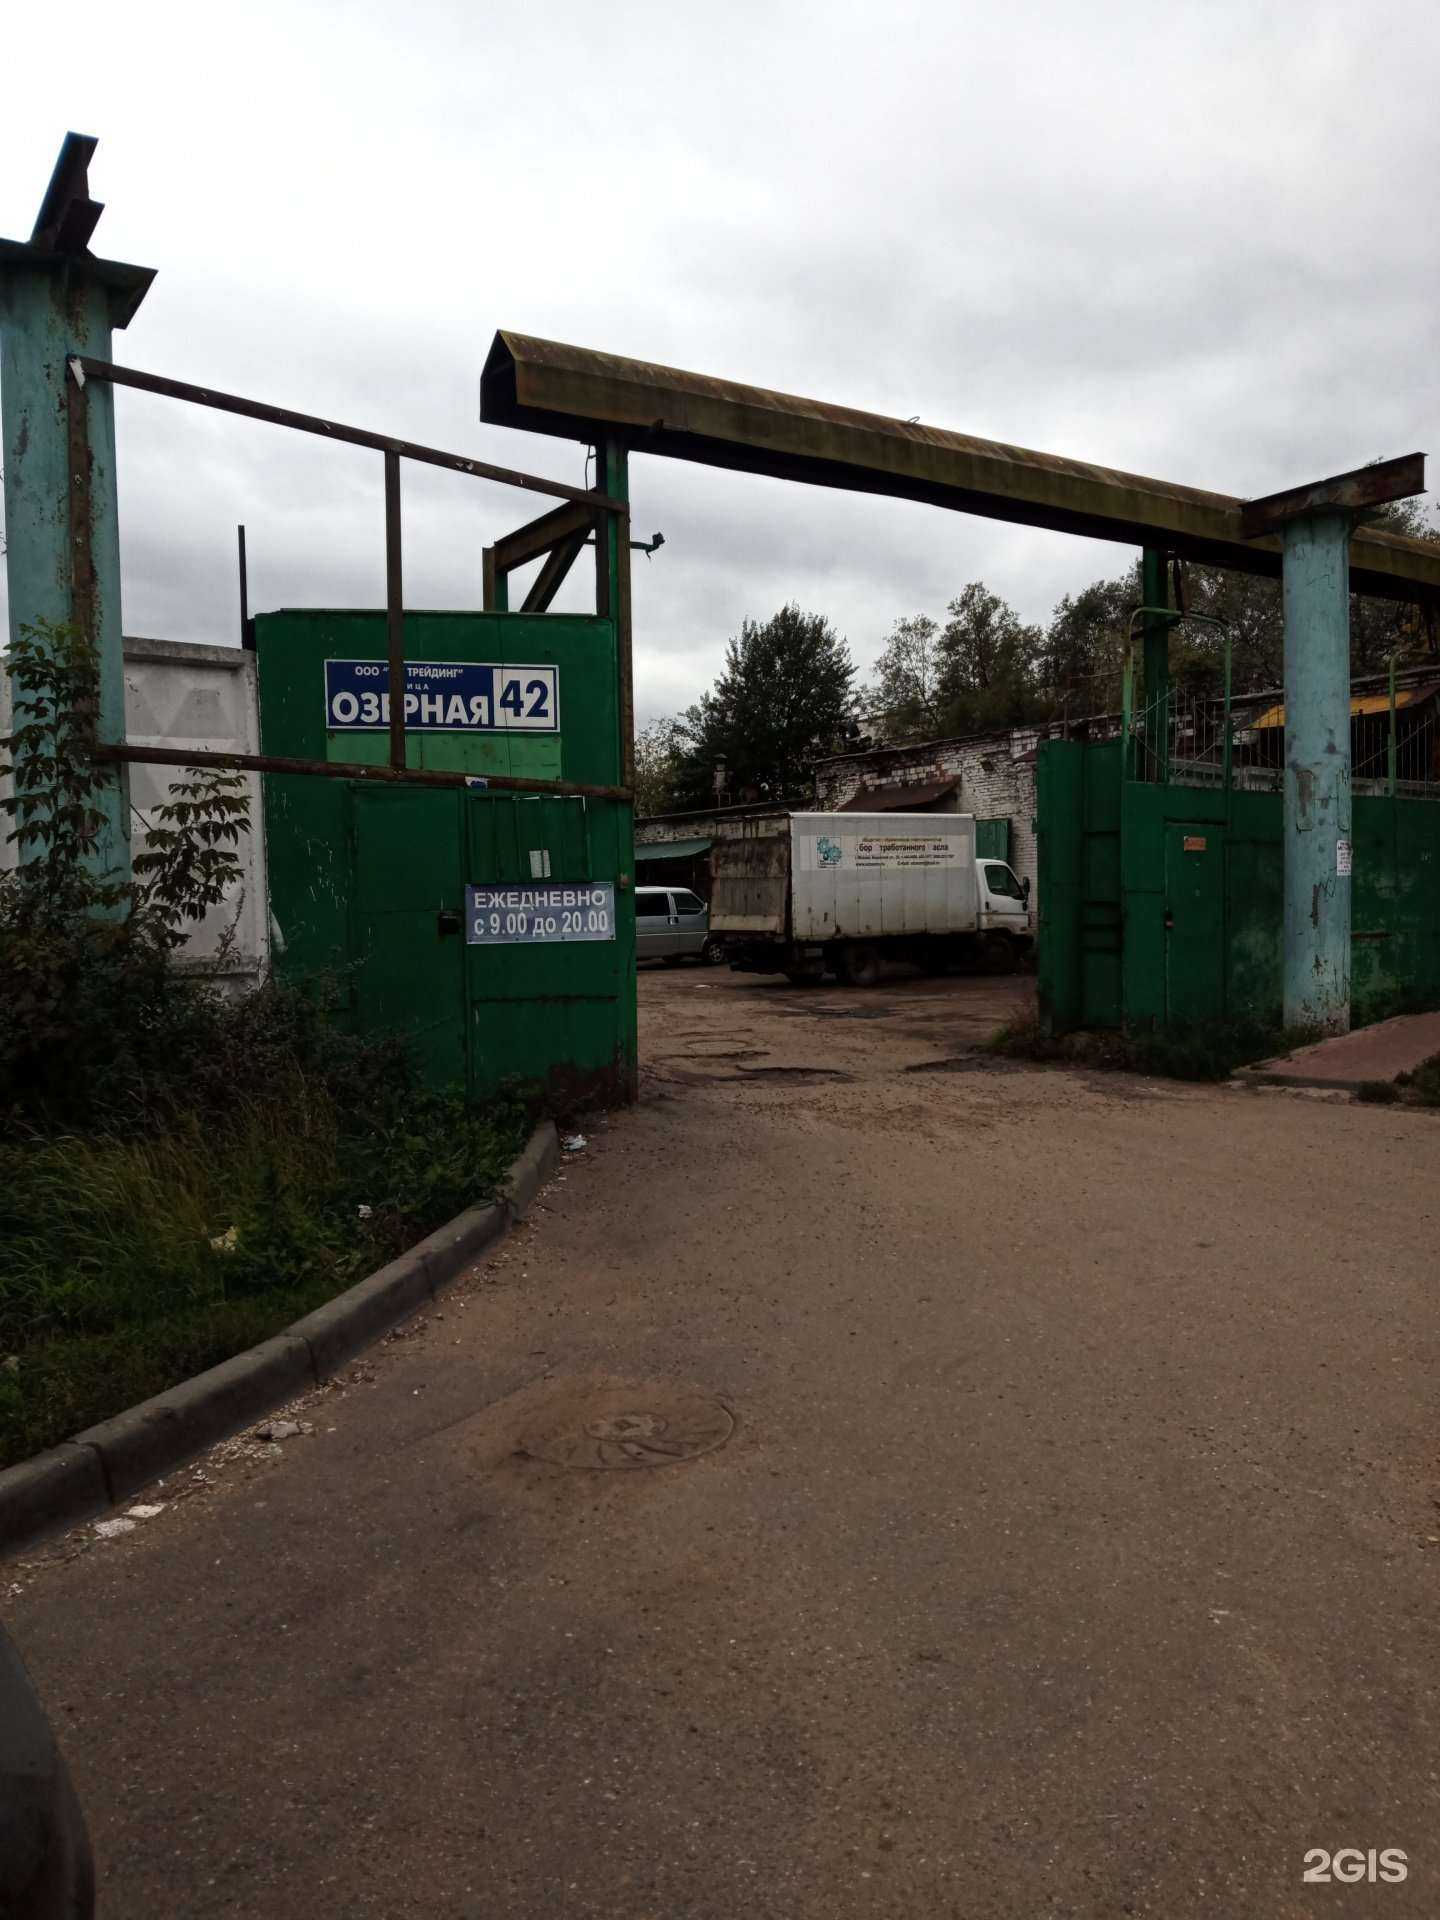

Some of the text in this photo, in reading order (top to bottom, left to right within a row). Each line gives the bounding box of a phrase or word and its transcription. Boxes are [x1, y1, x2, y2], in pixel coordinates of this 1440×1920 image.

[355, 666, 380, 676] ООО
[500, 679, 549, 718] 42
[474, 889, 606, 911] ЕЖЕДНЕВНО
[474, 910, 609, 937] с 9.00 до 20.00
